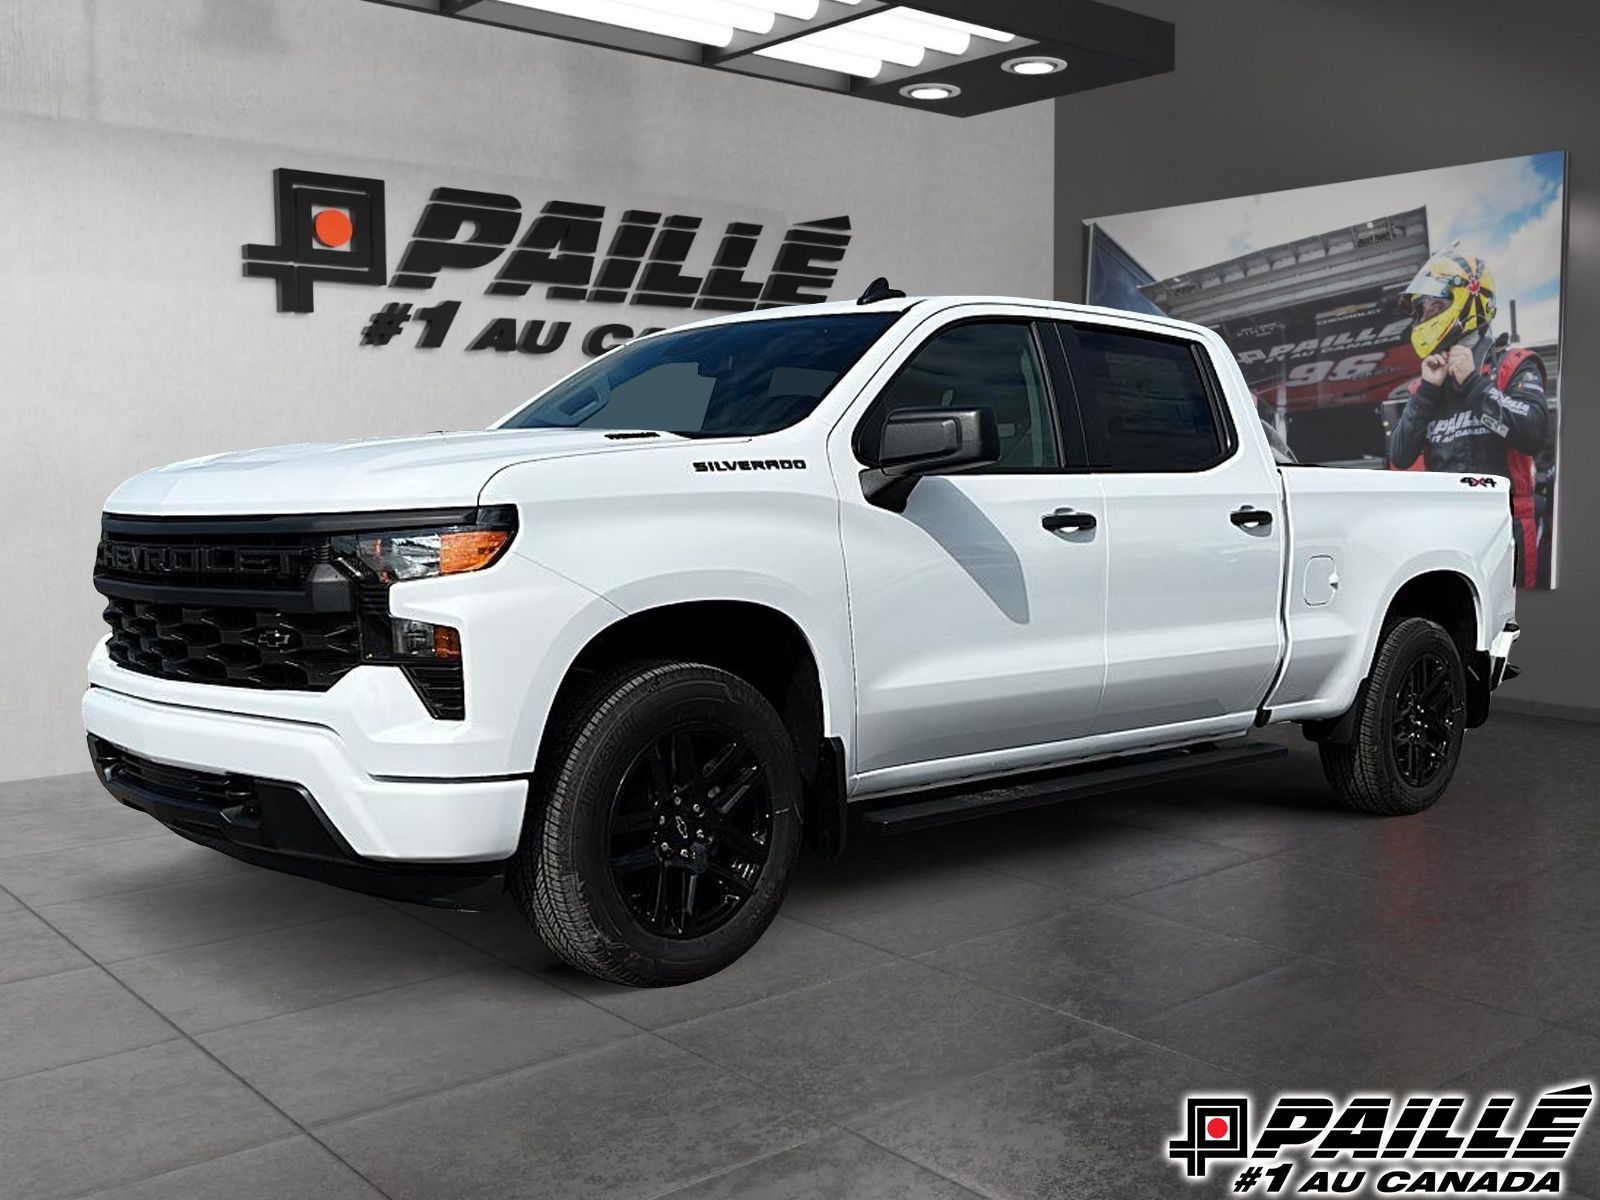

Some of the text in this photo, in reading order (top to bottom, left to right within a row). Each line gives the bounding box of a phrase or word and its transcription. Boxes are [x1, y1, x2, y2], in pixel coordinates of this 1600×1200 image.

[388, 187, 851, 310] PAILLÉ
[359, 300, 462, 348] #1
[464, 318, 572, 354] AU
[1286, 352, 1386, 387] 96
[693, 459, 806, 472] SILVERADO
